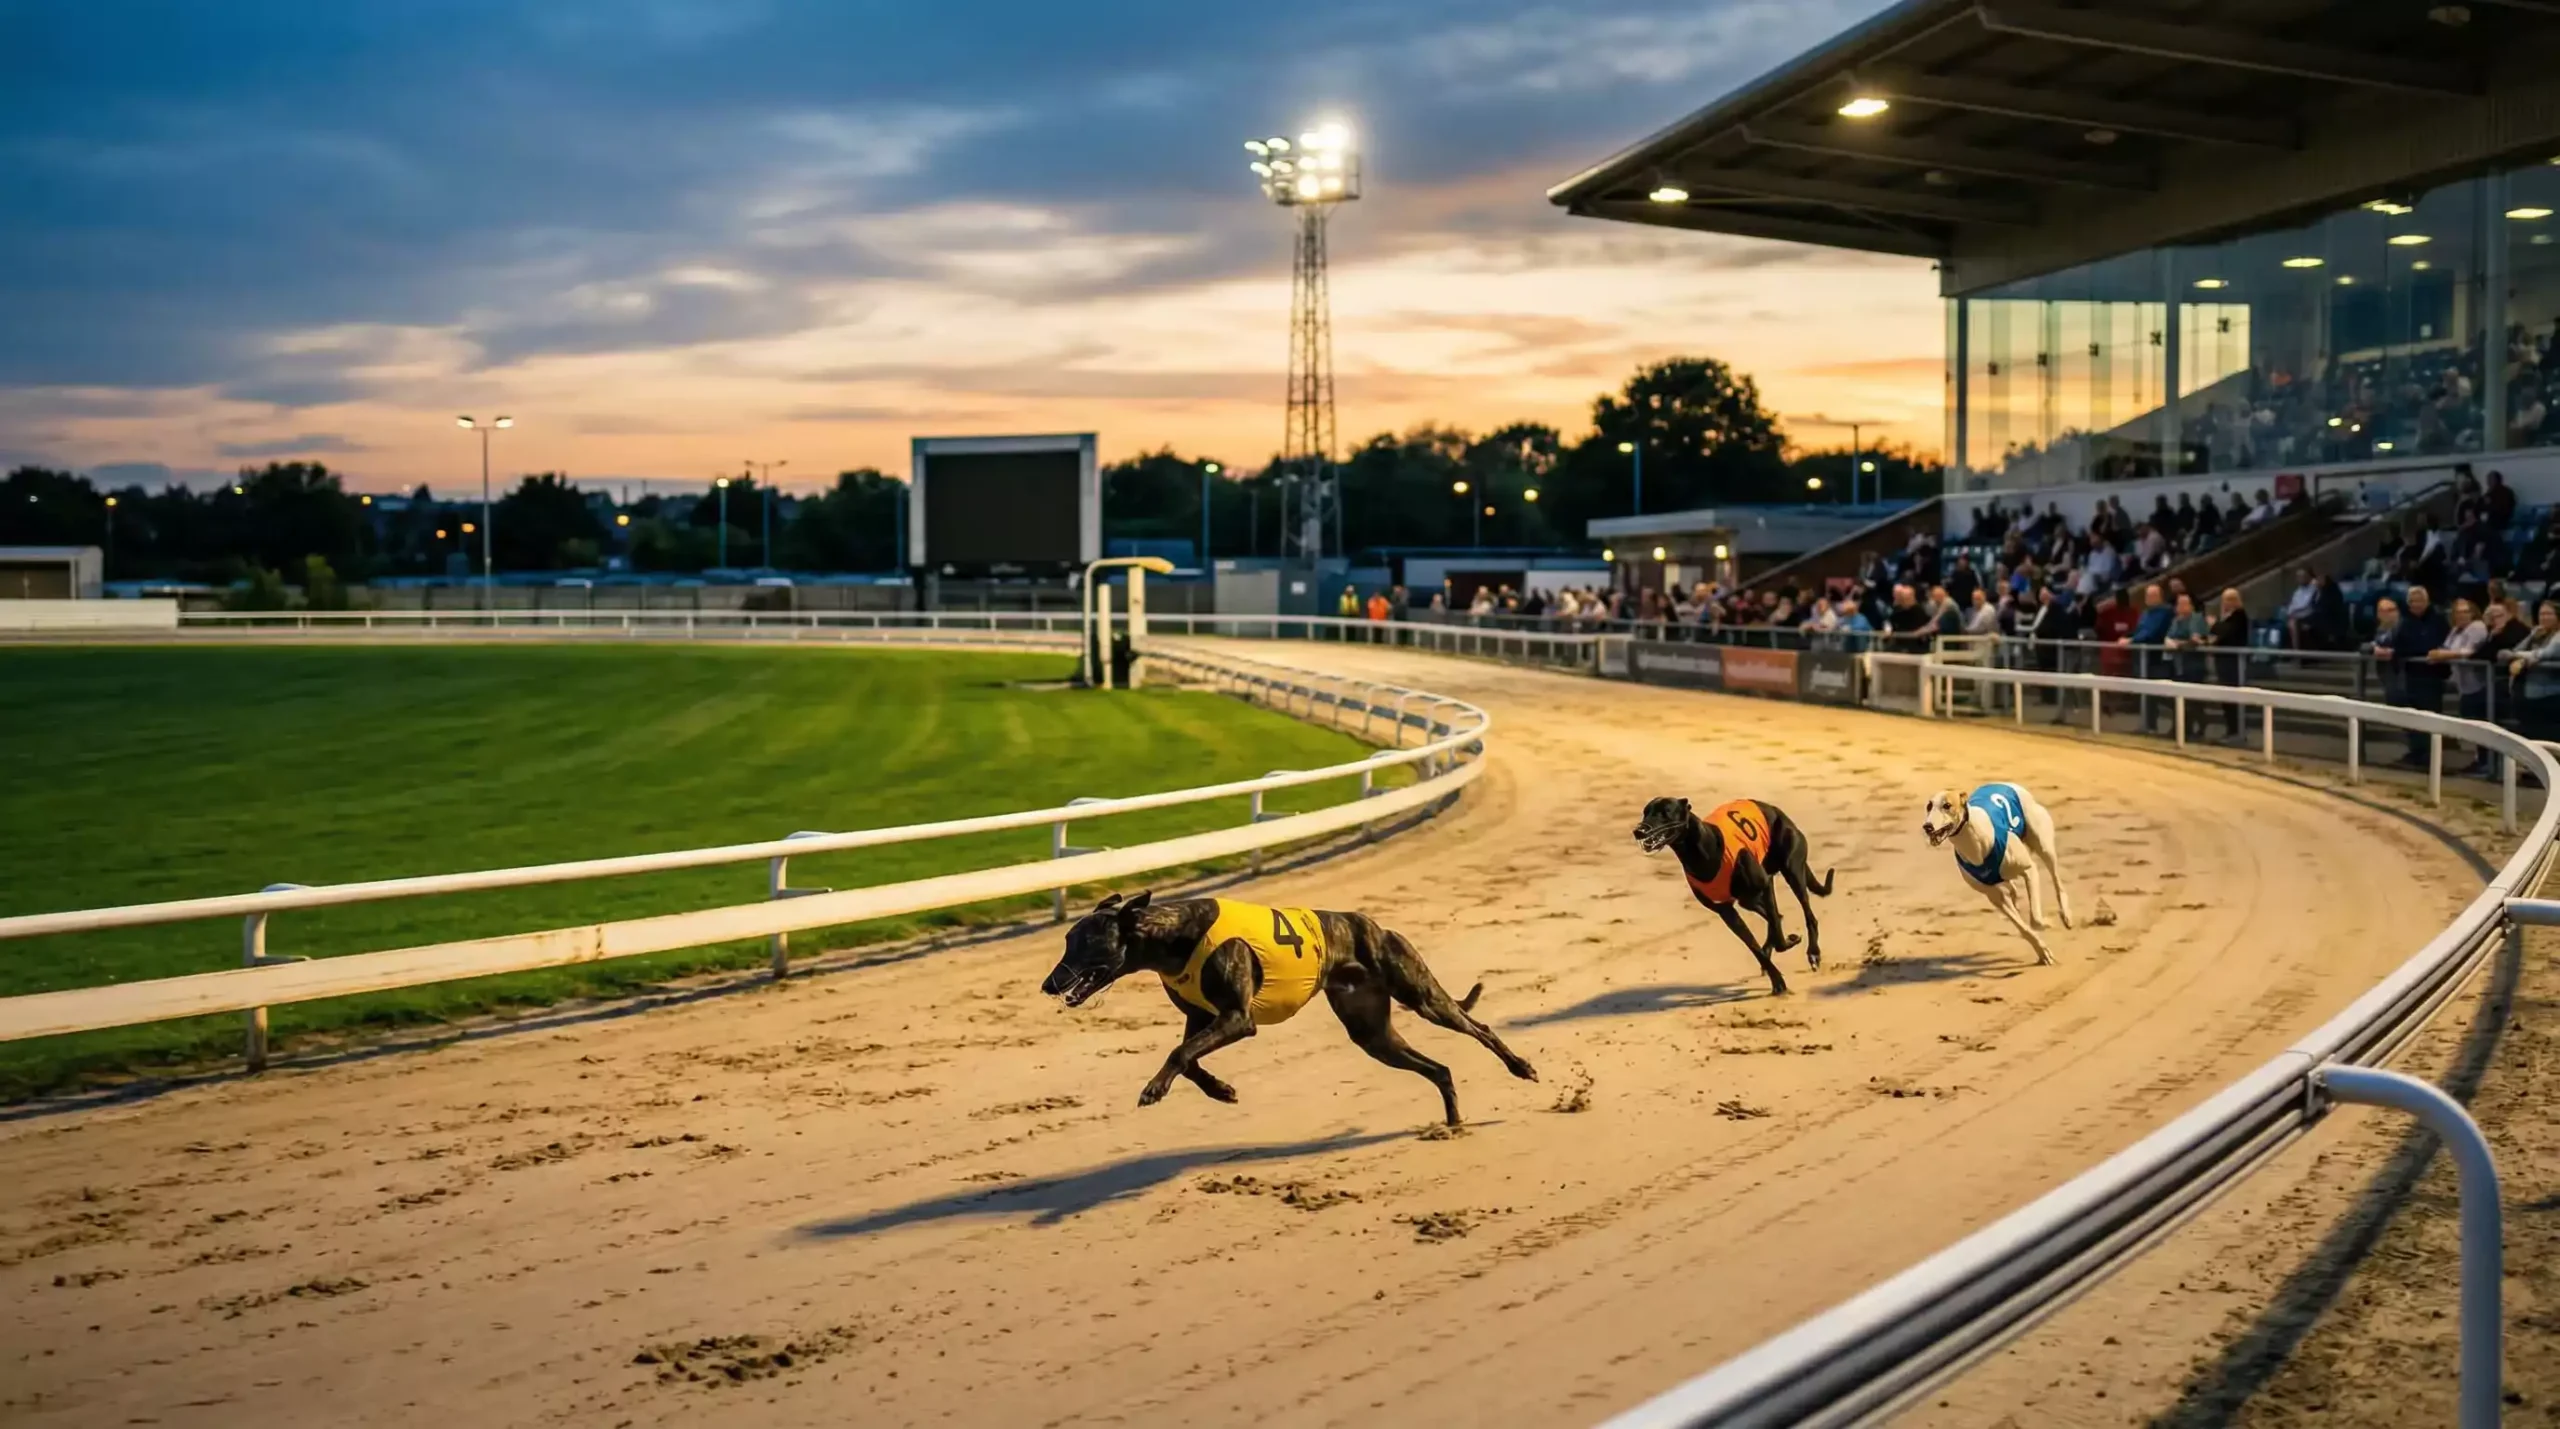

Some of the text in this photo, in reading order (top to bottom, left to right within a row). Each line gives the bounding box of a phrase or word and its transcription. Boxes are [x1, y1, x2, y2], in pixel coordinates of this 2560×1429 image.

[1727, 810, 1758, 841] 6
[1990, 793, 2020, 828] 2
[1270, 908, 1304, 959] 4
